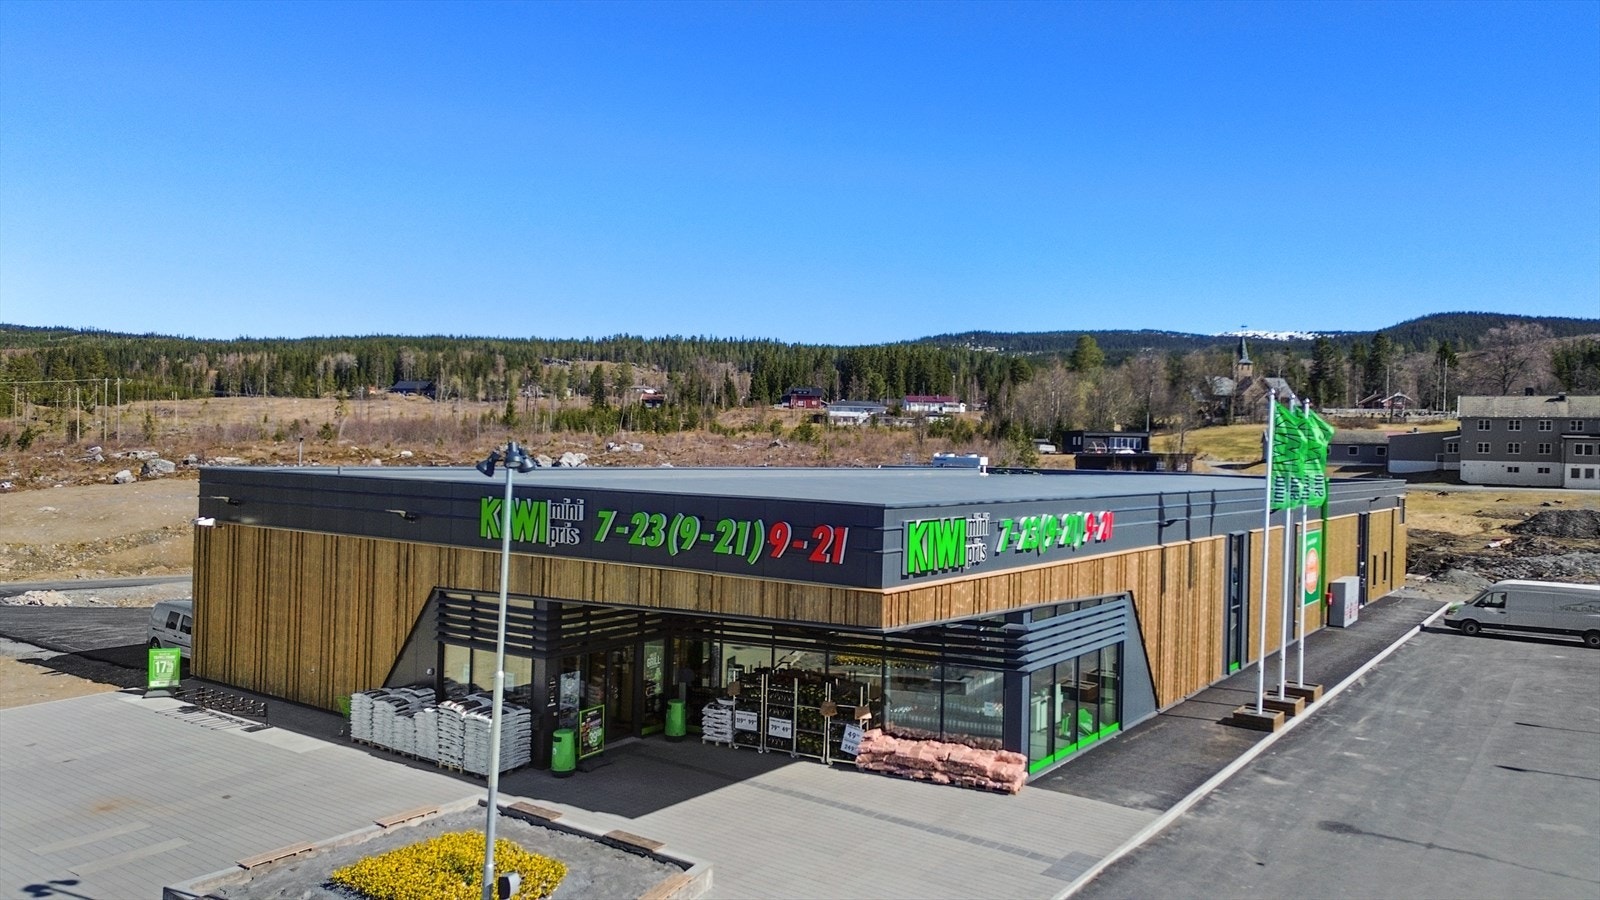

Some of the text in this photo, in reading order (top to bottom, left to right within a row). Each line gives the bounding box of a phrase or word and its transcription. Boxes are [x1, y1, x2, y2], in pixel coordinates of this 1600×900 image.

[550, 498, 585, 521] mini
[549, 522, 580, 547] pris
[966, 512, 991, 537] mini
[904, 516, 967, 575] KIWI
[965, 538, 987, 569] pris
